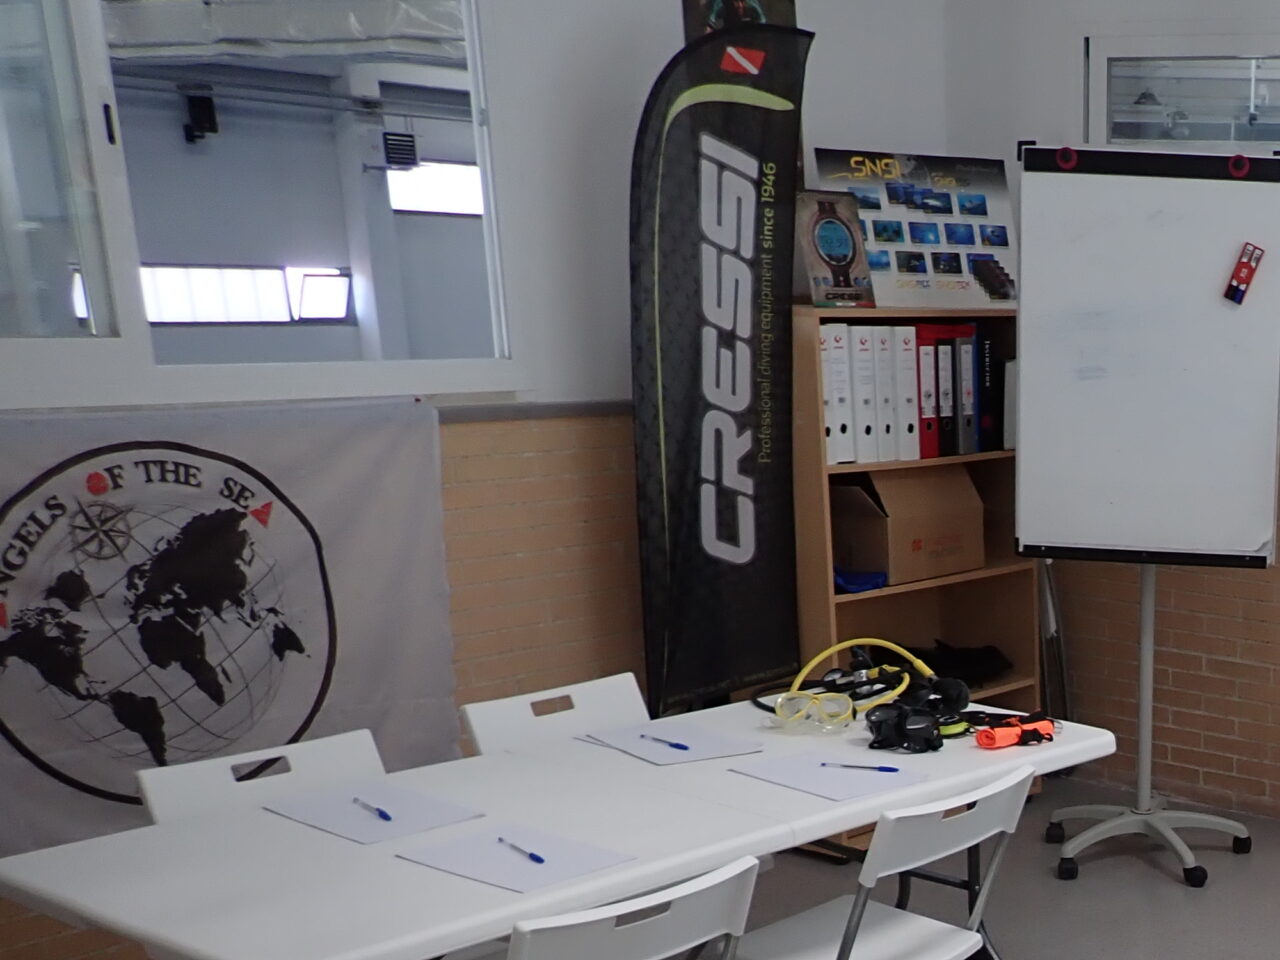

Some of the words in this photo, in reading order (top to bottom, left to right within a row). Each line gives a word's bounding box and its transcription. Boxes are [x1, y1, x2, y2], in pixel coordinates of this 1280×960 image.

[761, 162, 776, 202] 1946
[760, 208, 775, 248] since
[760, 254, 775, 330] equipment
[701, 133, 759, 564] CRESSI
[758, 334, 774, 376] diving
[758, 379, 772, 463] Professional
[134, 460, 202, 487] THE
